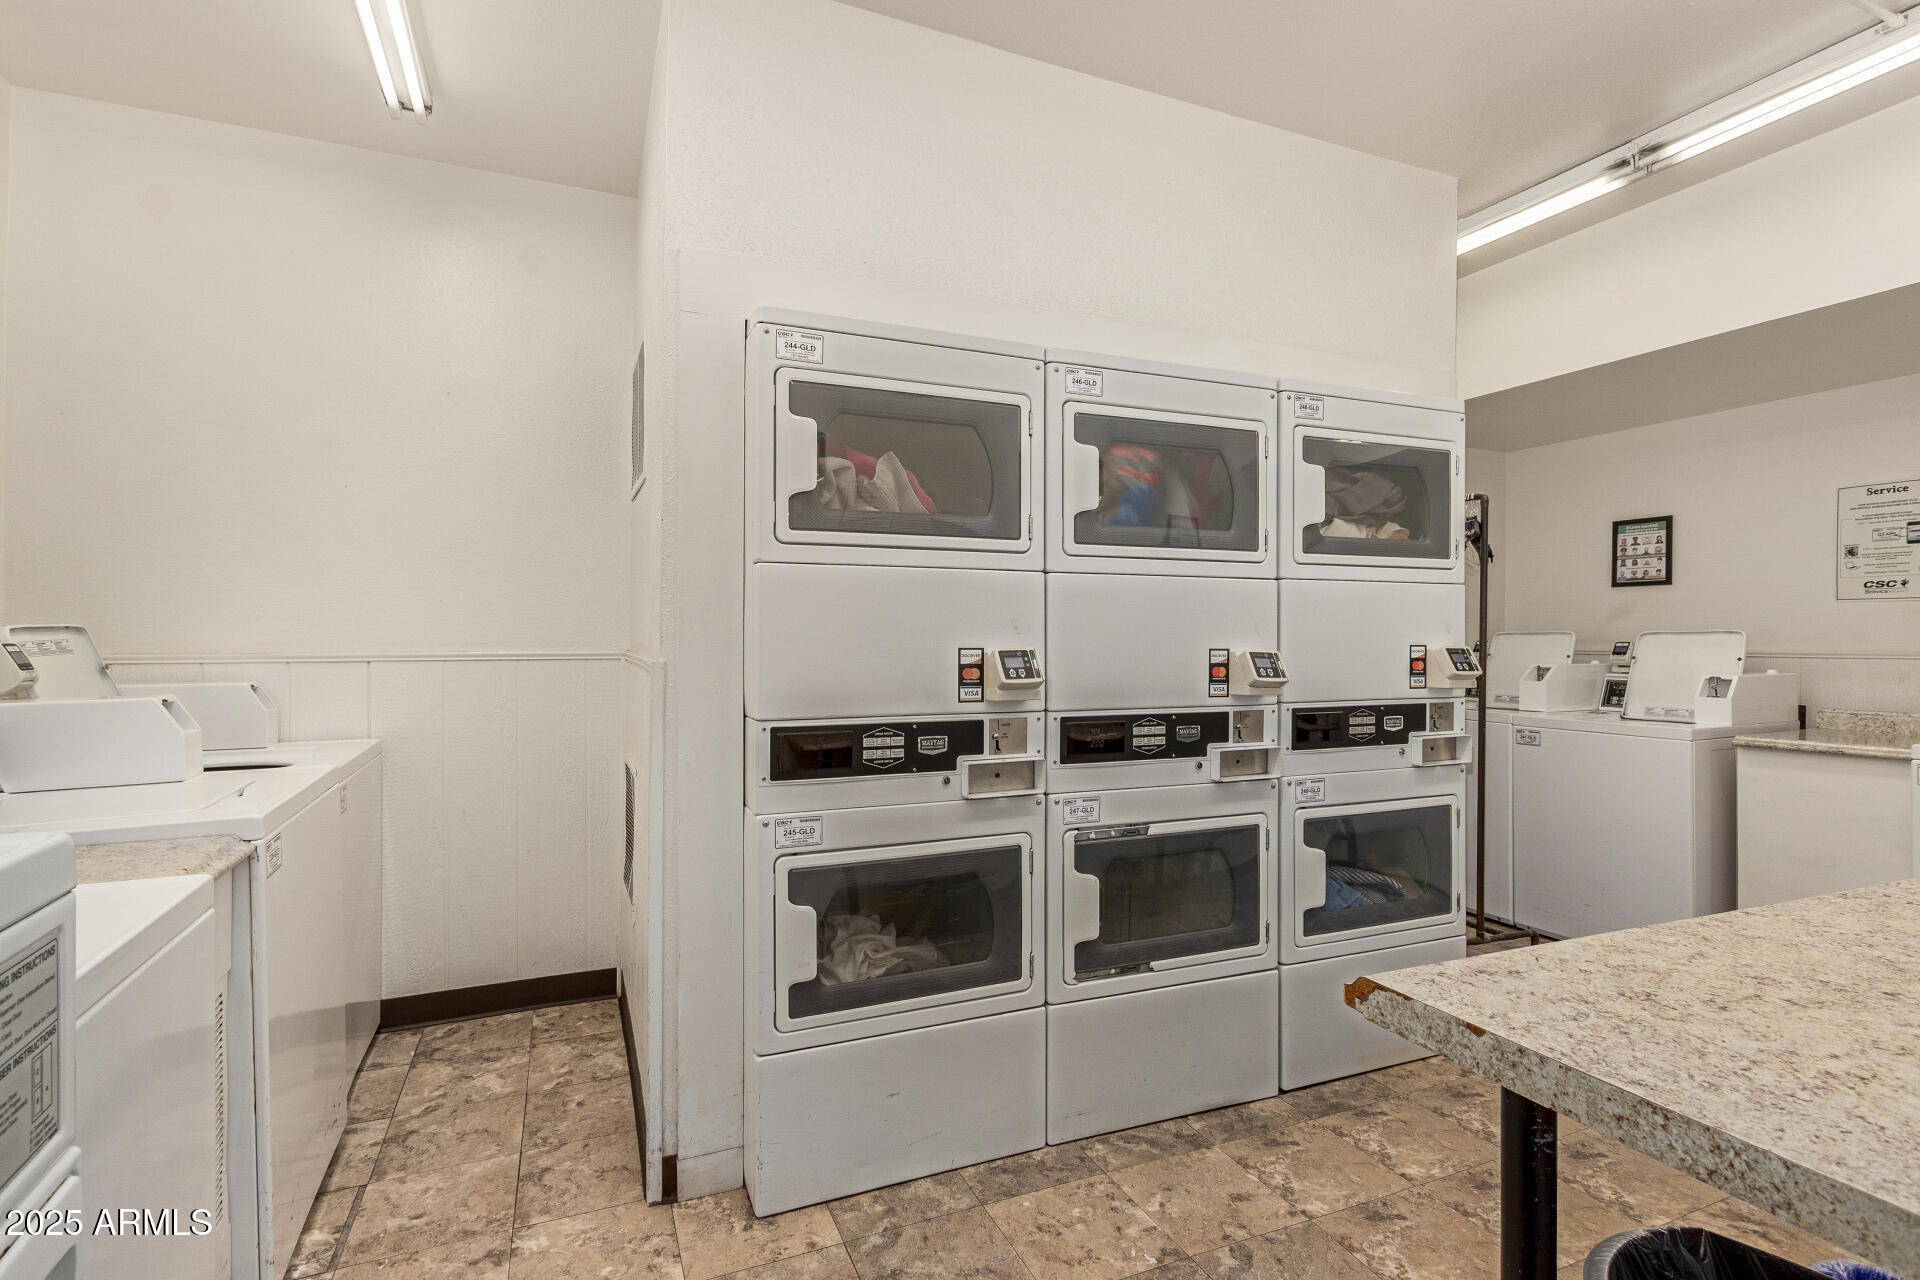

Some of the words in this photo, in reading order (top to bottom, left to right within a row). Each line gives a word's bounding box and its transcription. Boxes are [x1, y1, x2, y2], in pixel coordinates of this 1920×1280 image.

[784, 341, 817, 352] 244-GLD
[1072, 378, 1097, 387] 246-GLD
[1866, 485, 1909, 496] Service
[1863, 580, 1898, 589] CSC
[783, 827, 816, 837] 245-GLD
[11, 945, 56, 983] INSTRUCTIONS
[13, 1025, 56, 1070] INSTRUCTIONS
